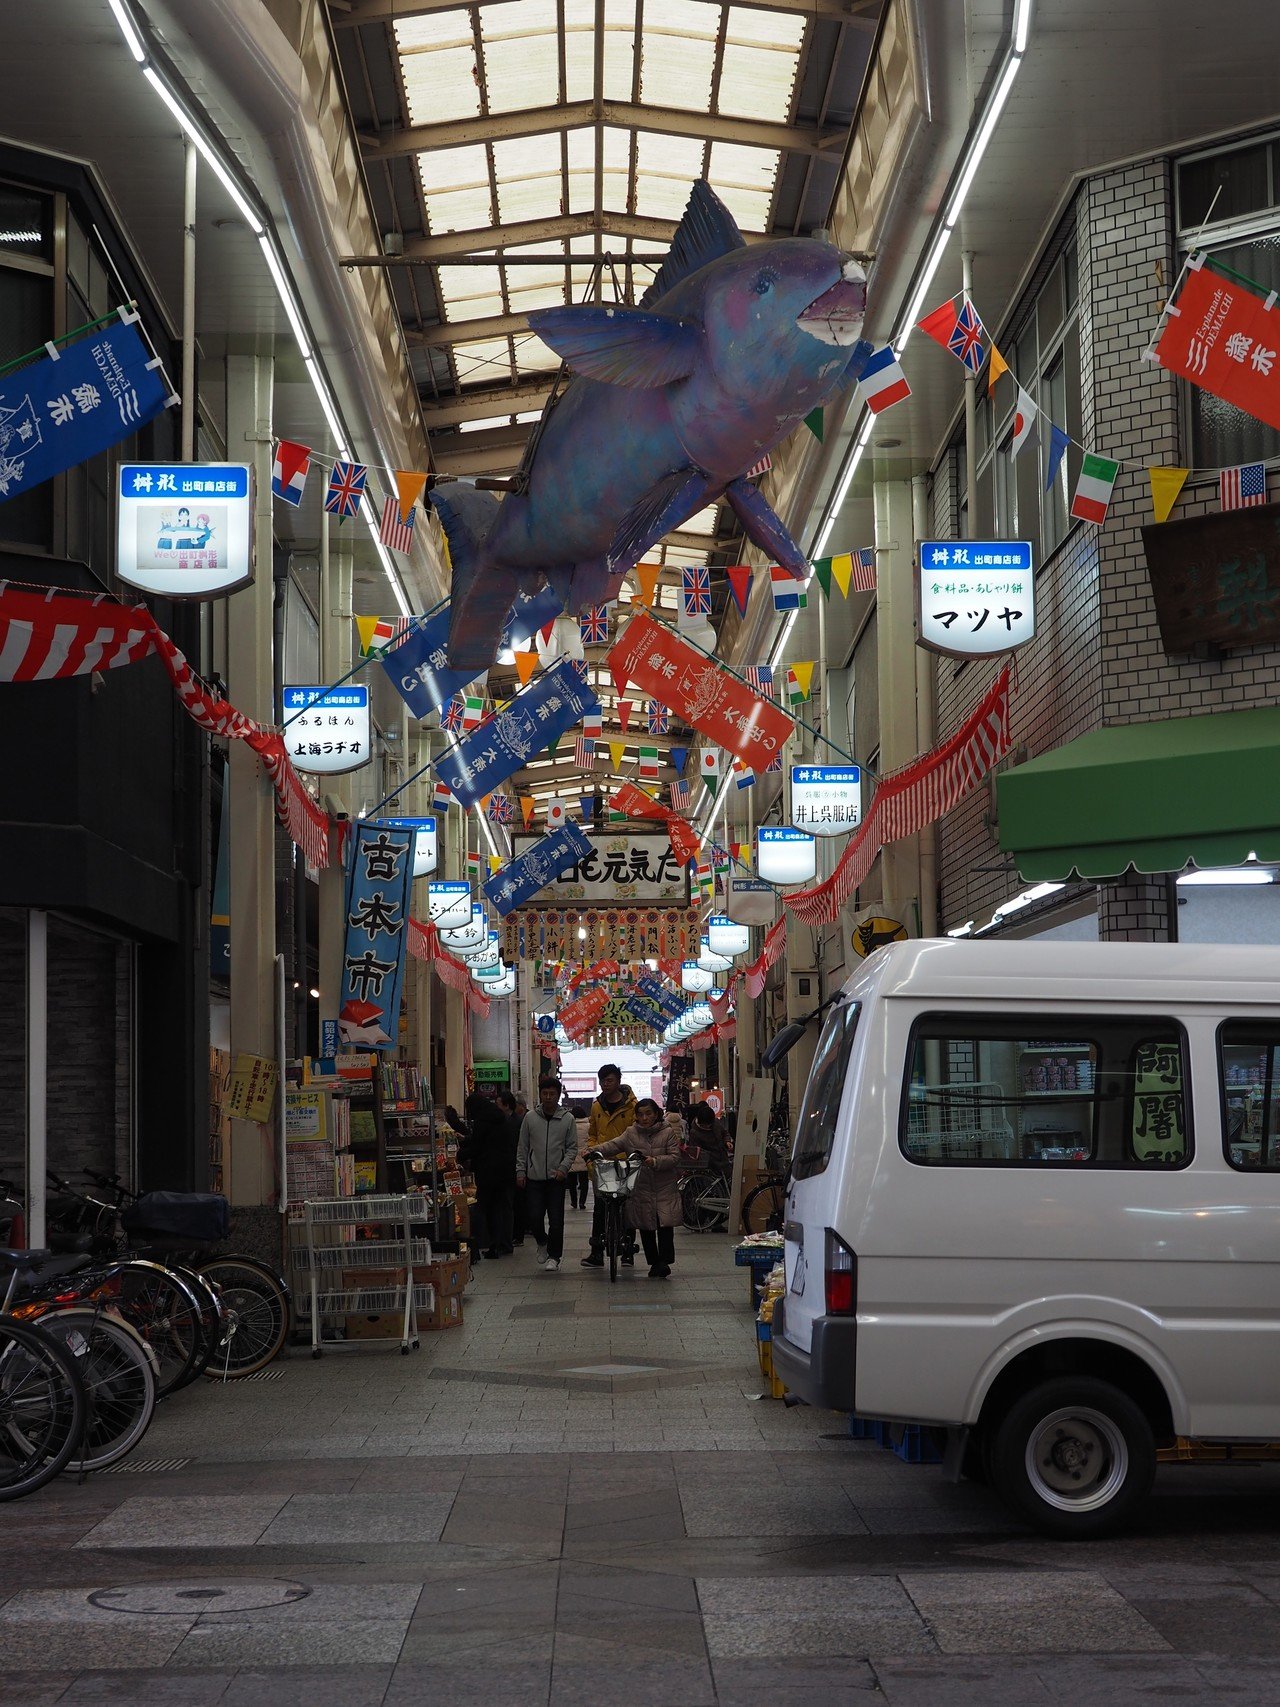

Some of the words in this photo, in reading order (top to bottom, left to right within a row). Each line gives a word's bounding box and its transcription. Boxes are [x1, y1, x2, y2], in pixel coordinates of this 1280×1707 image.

[1196, 288, 1224, 339] Esplanade
[1205, 293, 1234, 348] DEMACHI
[182, 481, 237, 492] 出町商店街
[179, 560, 217, 569] 商店街
[974, 555, 1021, 565] 出町商店街
[932, 606, 1023, 633] マツヤ
[637, 631, 658, 660] DEMACHI
[324, 696, 360, 704] 出町商店街
[298, 715, 354, 726] ふるほん
[293, 741, 361, 756] 上海ラヂオ
[795, 804, 858, 823] 井上呉服店
[346, 832, 409, 1003] 古本市
[687, 924, 698, 955] あられ
[1136, 1043, 1183, 1162] 阿闍
